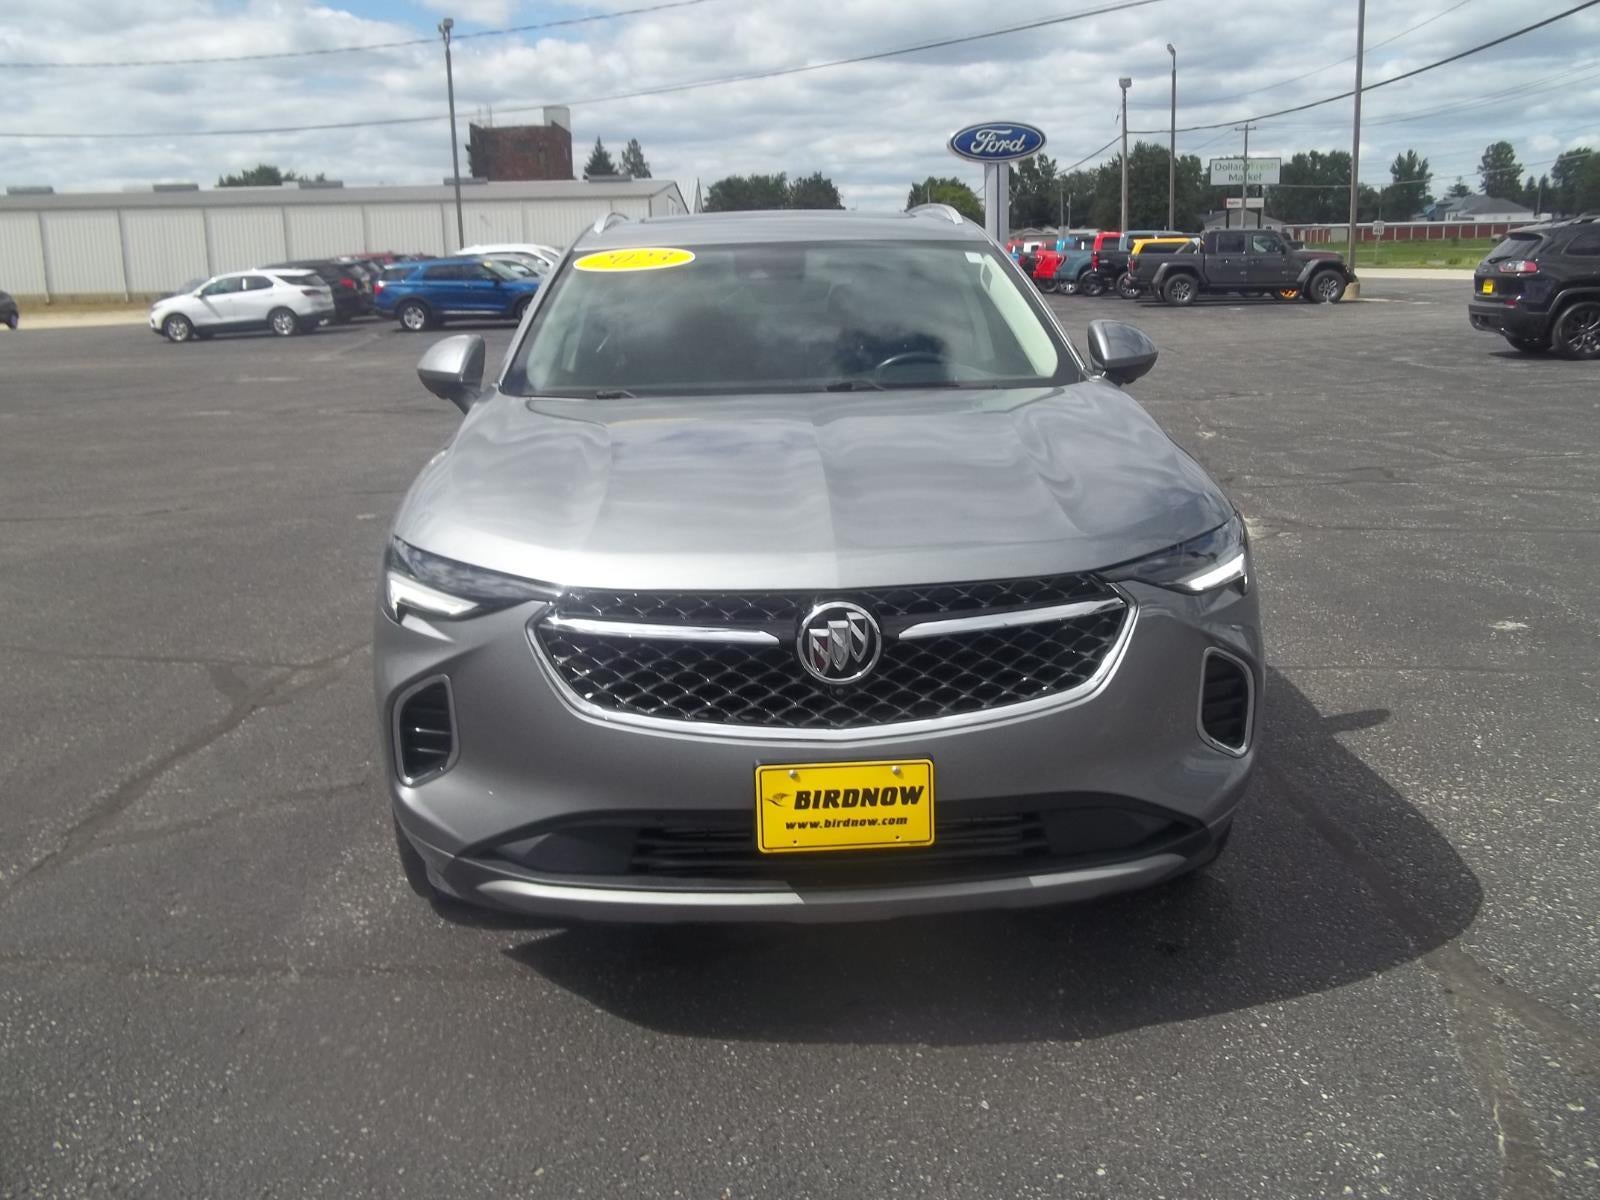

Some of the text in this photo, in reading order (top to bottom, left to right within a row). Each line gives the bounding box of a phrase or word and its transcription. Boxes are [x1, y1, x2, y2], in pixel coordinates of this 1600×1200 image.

[970, 129, 1027, 153] Ford
[1214, 162, 1243, 171] Dollar
[1228, 173, 1262, 181] Maket
[794, 786, 924, 810] BIRDNOW
[785, 816, 908, 830] www.birdnow.com
